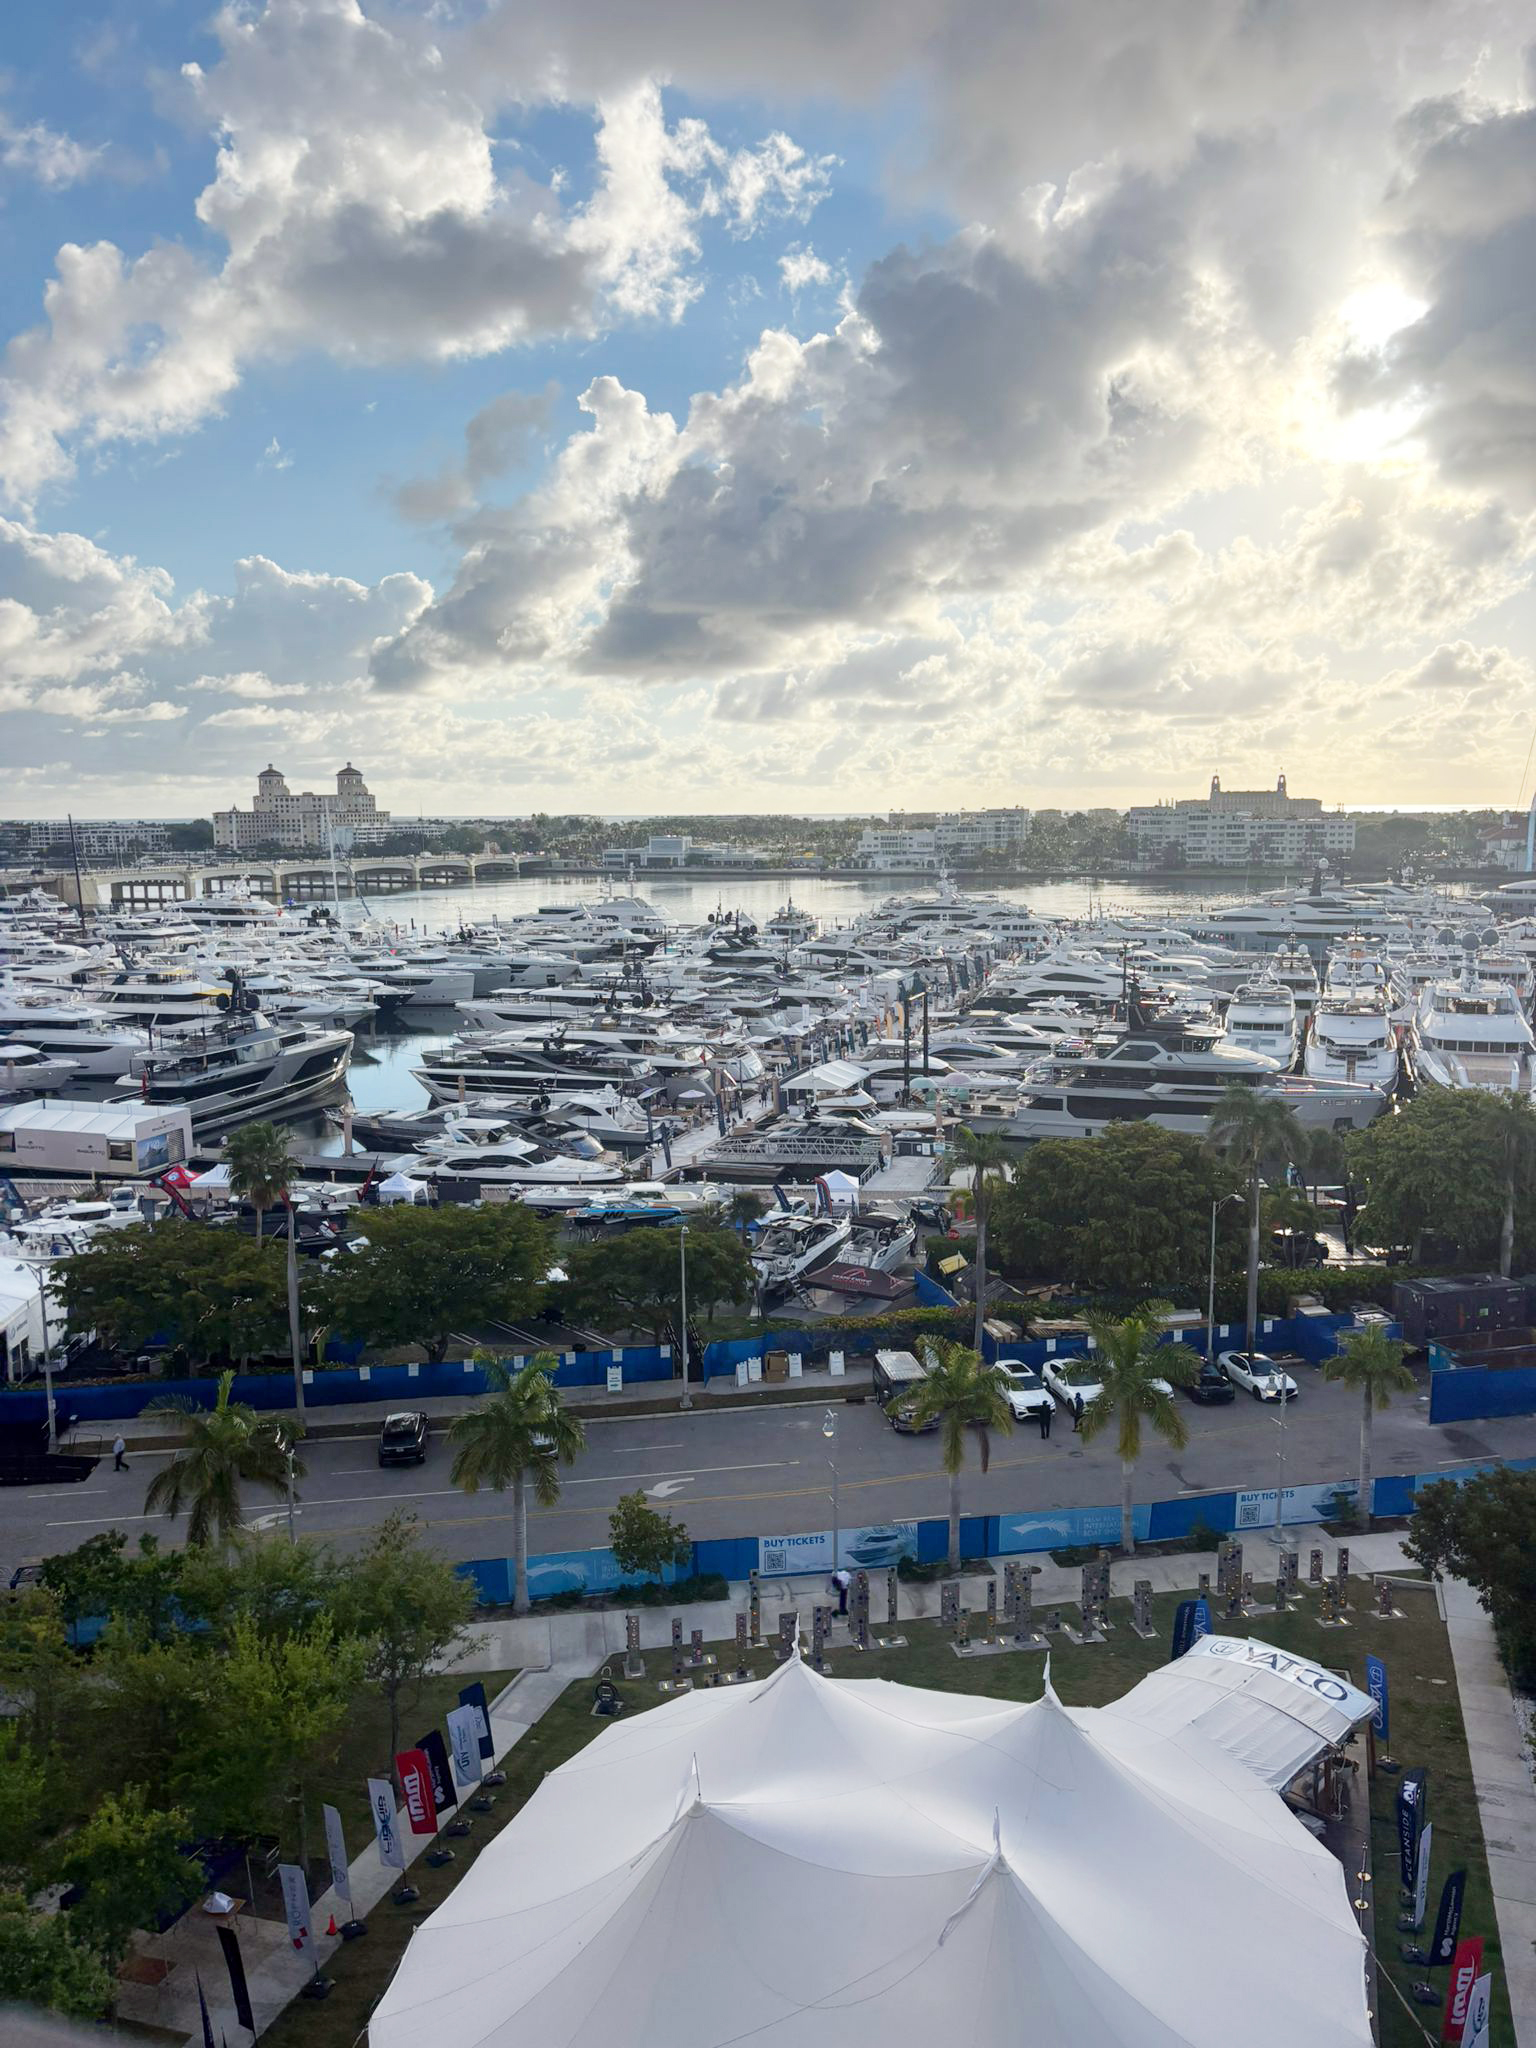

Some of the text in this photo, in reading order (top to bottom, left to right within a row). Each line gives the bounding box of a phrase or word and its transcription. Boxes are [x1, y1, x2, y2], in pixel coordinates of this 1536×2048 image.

[1241, 1493, 1259, 1502] BUY
[763, 1535, 826, 1548] BUY TICKETS
[1246, 1646, 1349, 1701] YATCO
